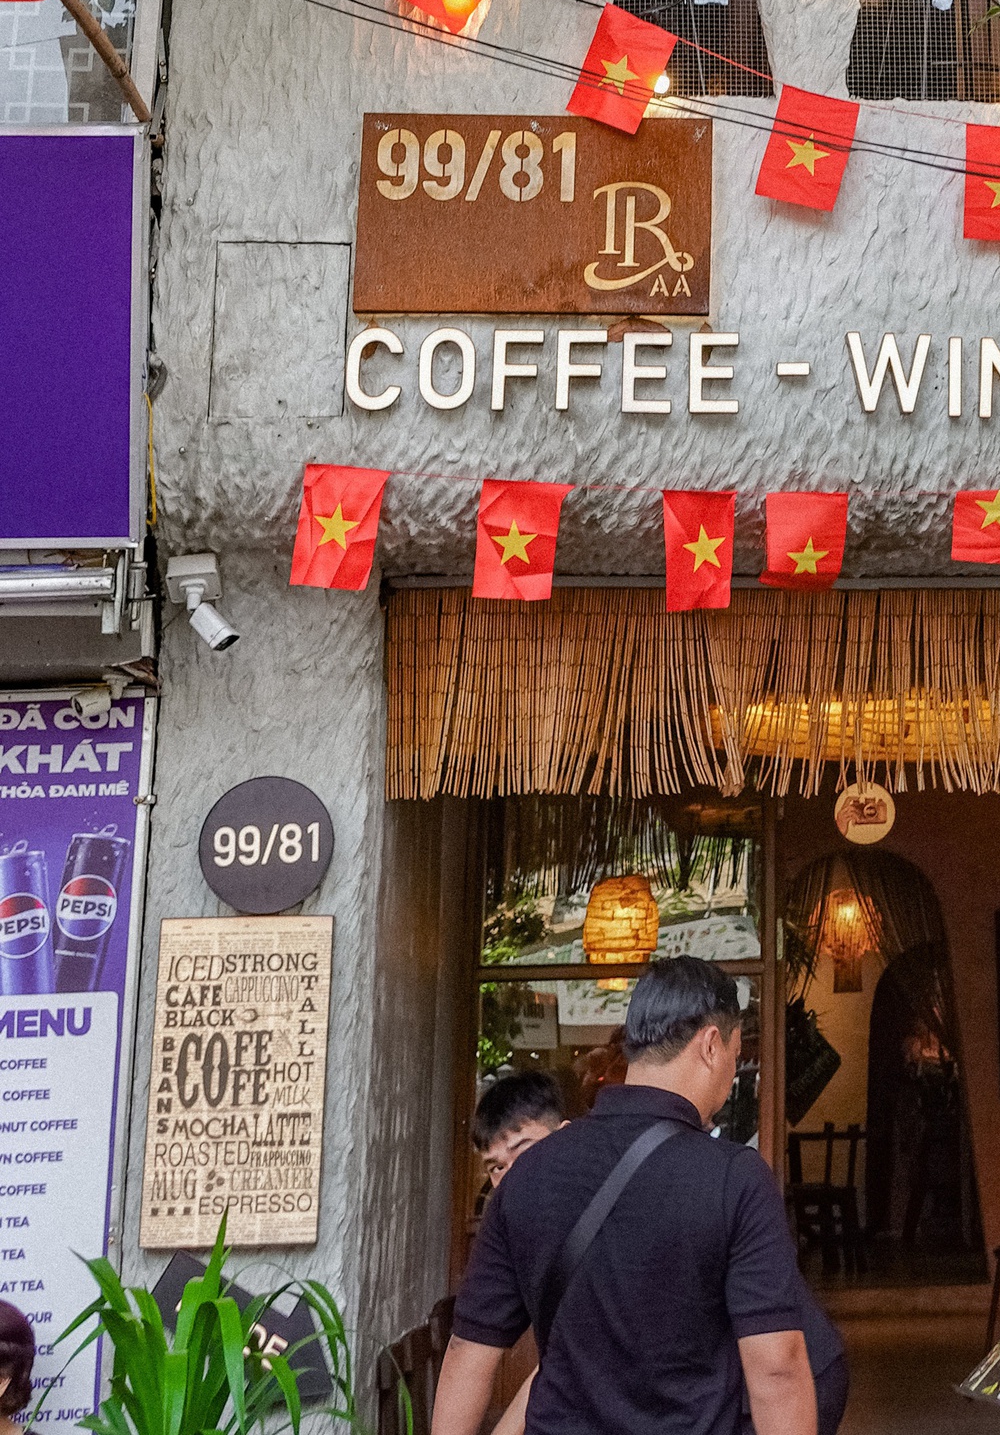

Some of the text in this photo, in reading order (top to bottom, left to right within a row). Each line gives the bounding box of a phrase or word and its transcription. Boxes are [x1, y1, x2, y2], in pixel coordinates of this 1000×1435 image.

[375, 128, 577, 203] 99/81
[346, 327, 740, 414] COFFEE
[0, 738, 133, 775] KHÁT
[0, 780, 130, 799] HỎA ĐAM MÊ
[213, 822, 321, 867] 99/81
[60, 898, 113, 917] PEPSI
[167, 954, 225, 982] ICED
[225, 952, 319, 973] STRONG
[165, 983, 223, 1008] CAFE
[224, 975, 300, 1004] CAPPUCCINO
[164, 1008, 236, 1028] BLACK
[298, 975, 319, 1057] TALL
[0, 1058, 48, 1071] COFFEE
[273, 1061, 315, 1083] HOT
[3, 1089, 51, 1102] COFFEE
[157, 1037, 175, 1134] BEANS
[272, 1085, 311, 1109] MILK
[30, 1119, 79, 1132] COFFEE
[171, 1115, 251, 1140] MOCHA
[252, 1112, 312, 1148] LATTE
[15, 1151, 63, 1164] COFFEE
[154, 1141, 250, 1168] ROASTED
[250, 1150, 312, 1168] FRAPPUCCINO
[0, 1183, 47, 1196] COFFEE
[150, 1170, 197, 1202] MUG
[229, 1168, 313, 1192] CREAMER
[198, 1193, 313, 1216] ESPRESSO
[6, 1216, 30, 1228] TEA
[2, 1248, 26, 1260] TEA
[21, 1280, 45, 1292] TEA
